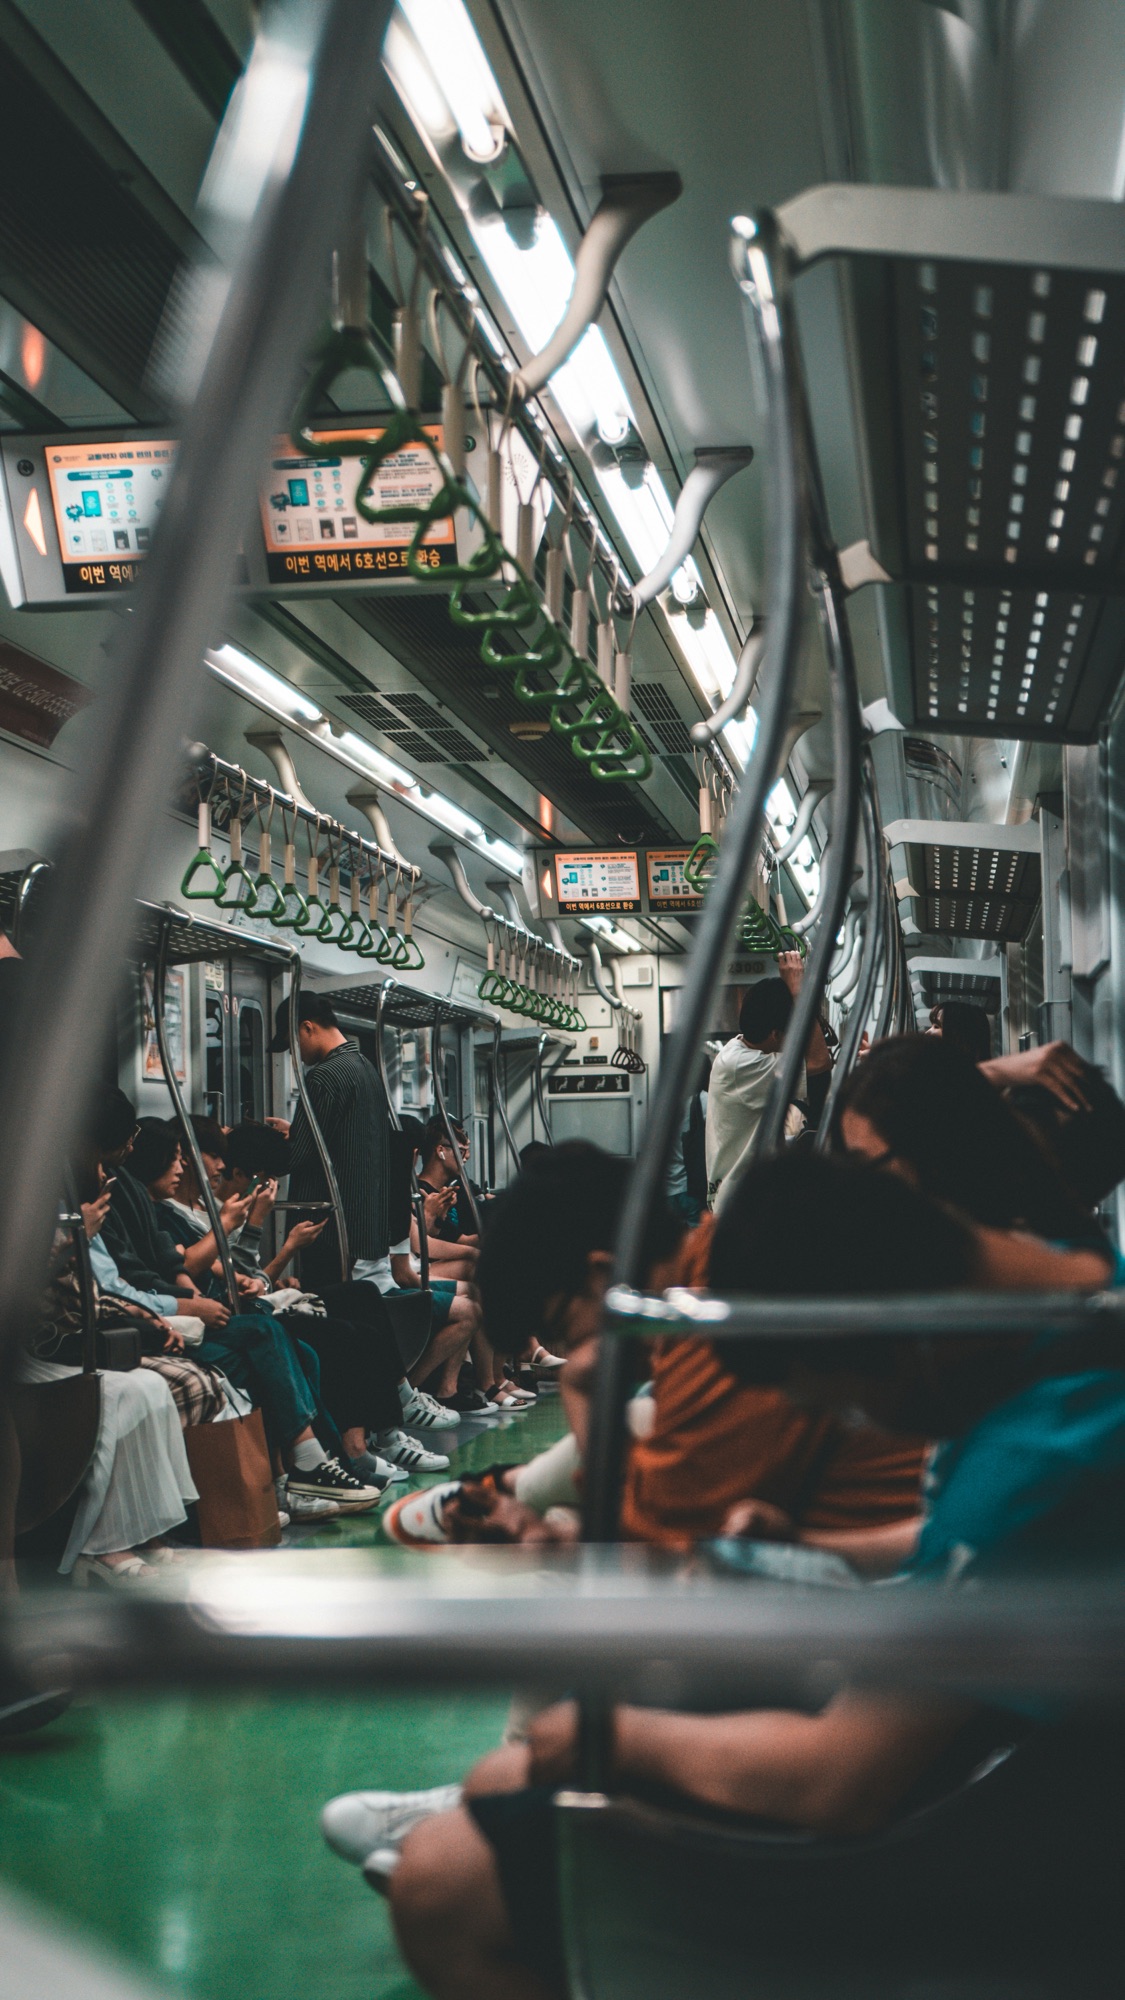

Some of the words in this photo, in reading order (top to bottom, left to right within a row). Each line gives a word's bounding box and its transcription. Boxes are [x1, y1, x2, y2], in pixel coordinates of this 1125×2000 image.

[286, 554, 310, 574] 이번
[314, 553, 351, 573] 역에서
[355, 551, 411, 570] 6호선으로
[80, 565, 105, 584] 이번
[565, 902, 578, 911] 이번
[578, 902, 595, 910] 역에서
[596, 901, 621, 910] 6호선으로
[623, 901, 634, 910] 환승
